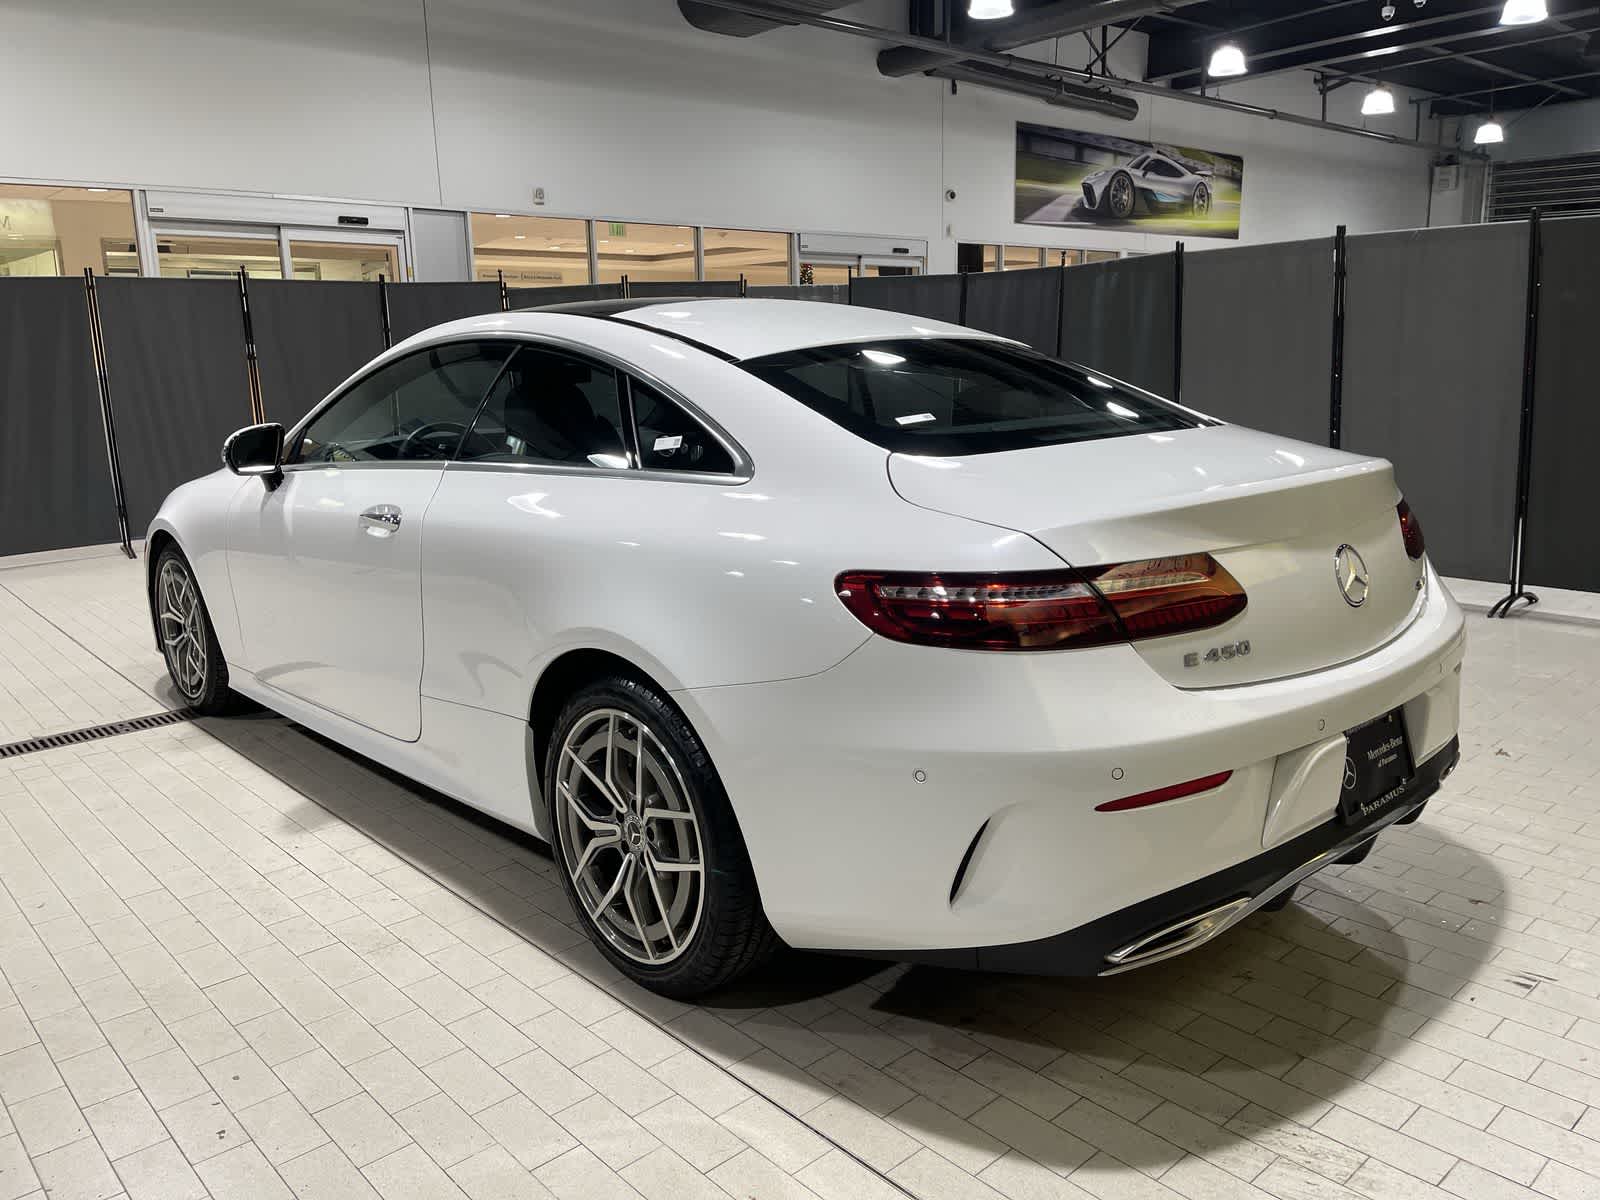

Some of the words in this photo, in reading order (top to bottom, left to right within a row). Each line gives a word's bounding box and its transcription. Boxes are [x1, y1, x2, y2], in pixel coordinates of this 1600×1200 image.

[1184, 651, 1199, 667] E
[1203, 640, 1250, 662] 450
[1363, 785, 1405, 816] PARAMUS
